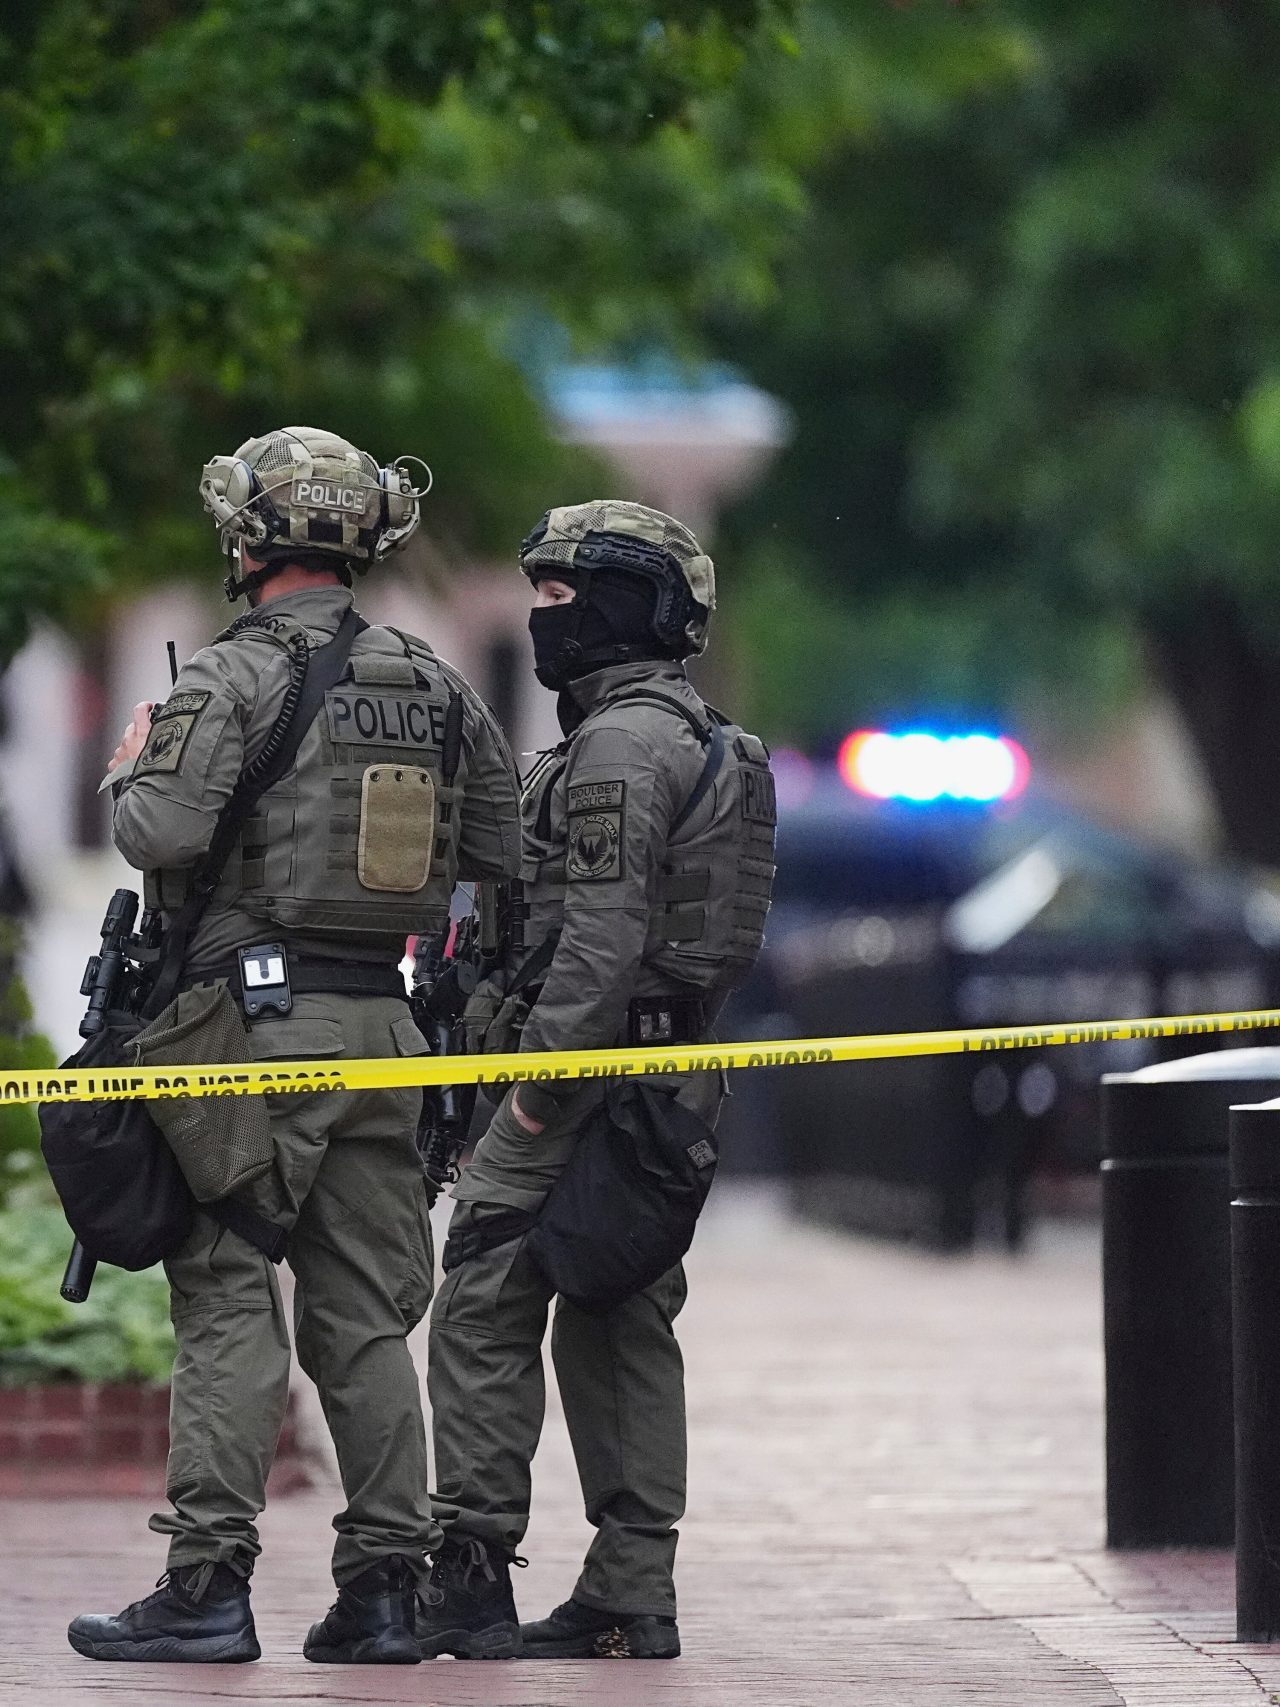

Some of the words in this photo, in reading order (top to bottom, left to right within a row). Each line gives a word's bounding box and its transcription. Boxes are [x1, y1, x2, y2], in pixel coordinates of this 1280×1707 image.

[297, 483, 364, 510] POLICE
[331, 696, 445, 746] POLICE
[570, 783, 619, 800] BOULDER
[575, 794, 612, 809] POLICE
